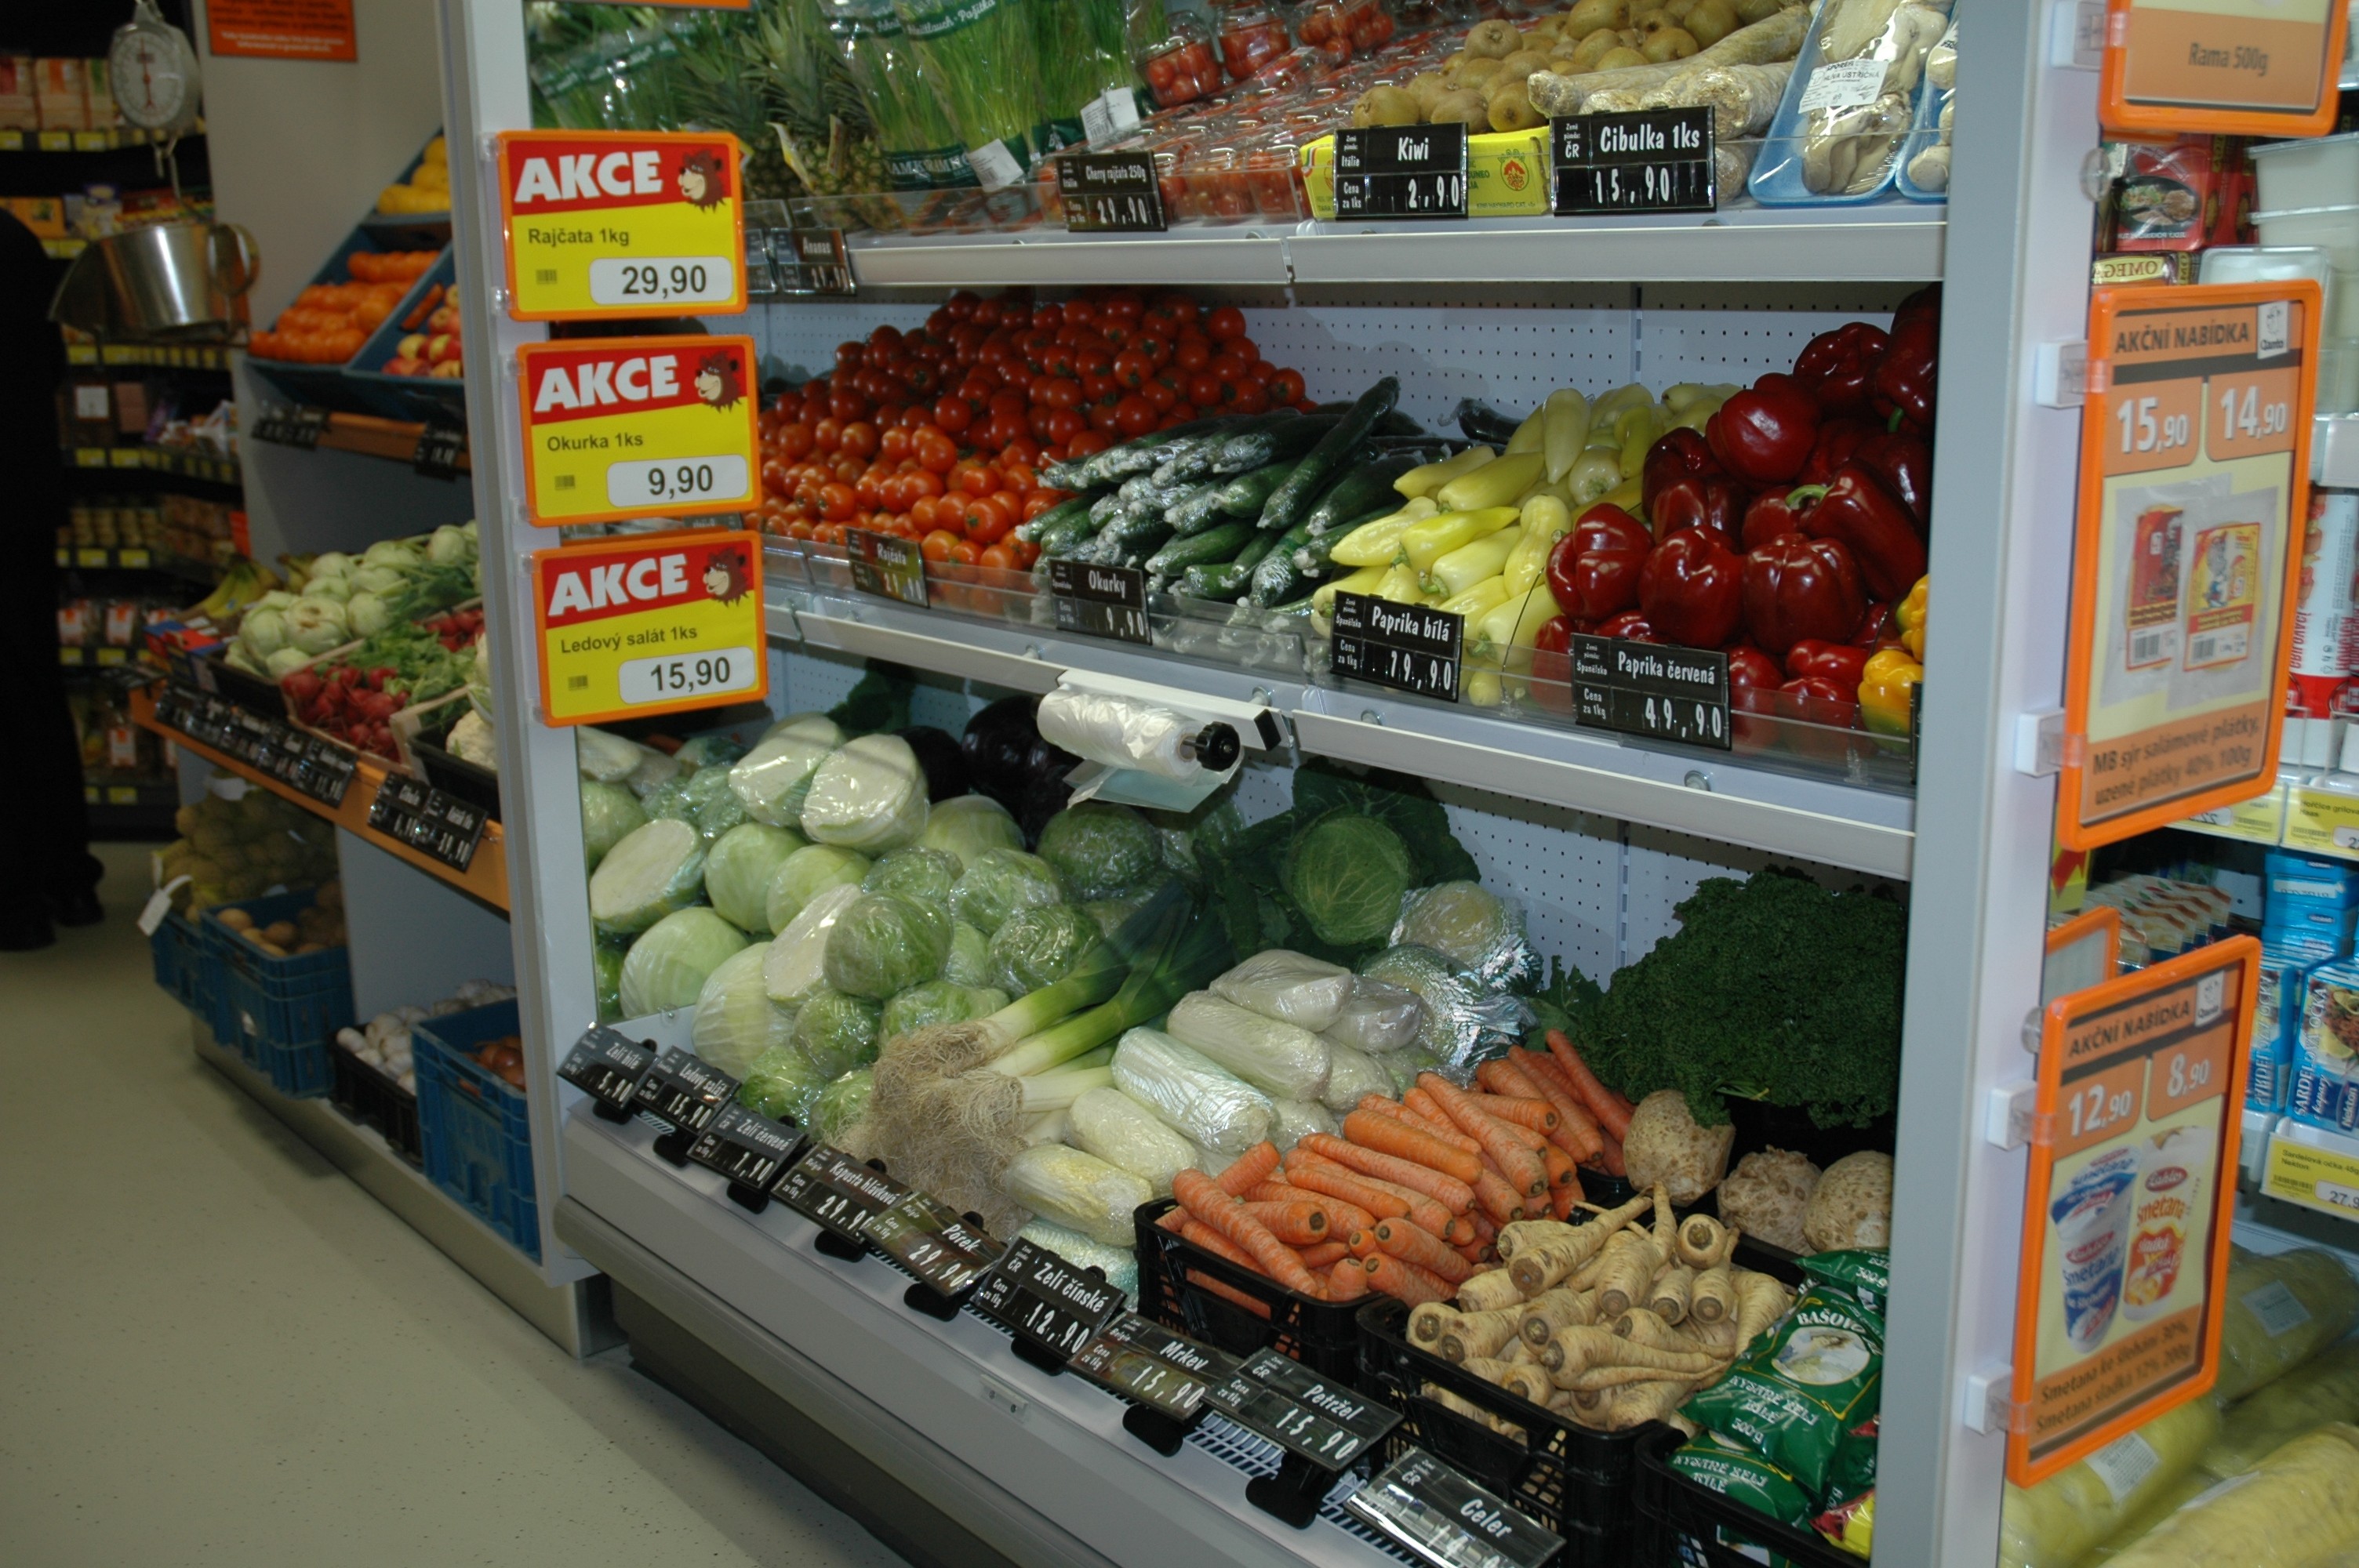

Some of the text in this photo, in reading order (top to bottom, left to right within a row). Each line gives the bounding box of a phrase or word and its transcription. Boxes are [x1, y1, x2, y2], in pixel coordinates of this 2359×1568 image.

[2188, 42, 2269, 77] Rama 500g
[1398, 136, 1430, 161] Kiwi
[1565, 140, 1579, 158] ČR
[1600, 121, 1700, 153] Cibulka 1ks
[514, 151, 663, 203] AKCE
[1085, 165, 1107, 183] Cherry
[1129, 164, 1147, 183] 250g
[1343, 182, 1360, 194] Cena
[1595, 165, 1670, 204] 15,90
[1408, 175, 1459, 209] 2,90
[528, 228, 630, 247] Rajčata 1kg
[621, 265, 707, 299] 29,90
[2115, 319, 2250, 354] AKČNÍ NABÍDKA
[533, 355, 680, 413] AKCE
[2117, 396, 2188, 454] 15,90
[2219, 385, 2288, 439] 14,90
[547, 433, 643, 452] Okurka 1ks
[648, 464, 713, 499] 9,90
[877, 543, 907, 566] Rajčata
[547, 554, 689, 617] AKCE
[1088, 569, 1126, 600] Okurky
[1106, 606, 1144, 637] 9,90
[1371, 605, 1451, 643] Paprika bílá
[561, 626, 698, 654] Ledový salát 1ks
[1339, 639, 1355, 653] Cena
[650, 656, 731, 693] 15,90
[1337, 655, 1345, 664] za
[1576, 661, 1608, 676] Španělsko
[1617, 650, 1716, 685] Paprika červená
[1583, 688, 1602, 702] Cena
[1583, 704, 1606, 720] za 1kg
[1645, 697, 1722, 739] 49,90
[2308, 987, 2329, 1029] OČKA
[2069, 1000, 2190, 1058] AKČNÍ NABÍDKA
[678, 1062, 728, 1097] Ledový salát
[2166, 1053, 2211, 1098] 8,90
[2069, 1083, 2132, 1138] 12,90
[2341, 1086, 2358, 1127] Nekton
[736, 1118, 794, 1152] Zelí červené
[791, 1174, 806, 1187] Cena
[829, 1160, 901, 1206] Kapusta hlávková
[885, 1216, 900, 1230] Cena
[942, 1223, 981, 1253] Pórek
[1007, 1256, 1023, 1273] ČR
[992, 1277, 1009, 1294] Cena
[1034, 1261, 1110, 1313] Zelí čínské
[1026, 1301, 1090, 1355] 12,90
[1081, 1354, 1089, 1364] za
[1092, 1343, 1110, 1358] Cena
[1159, 1340, 1209, 1371] Mrkev
[1131, 1365, 1206, 1409] 15,90
[1230, 1378, 1250, 1395] Cena
[1252, 1364, 1270, 1379] ČR
[2042, 1367, 2098, 1404] Smetana
[1217, 1388, 1241, 1408] za 1kg
[1303, 1384, 1365, 1421] Petržel
[2036, 1396, 2093, 1433] Smetana
[1275, 1407, 1359, 1461] 15,90
[1401, 1468, 1422, 1487] ČR
[1459, 1498, 1513, 1539] Celer
